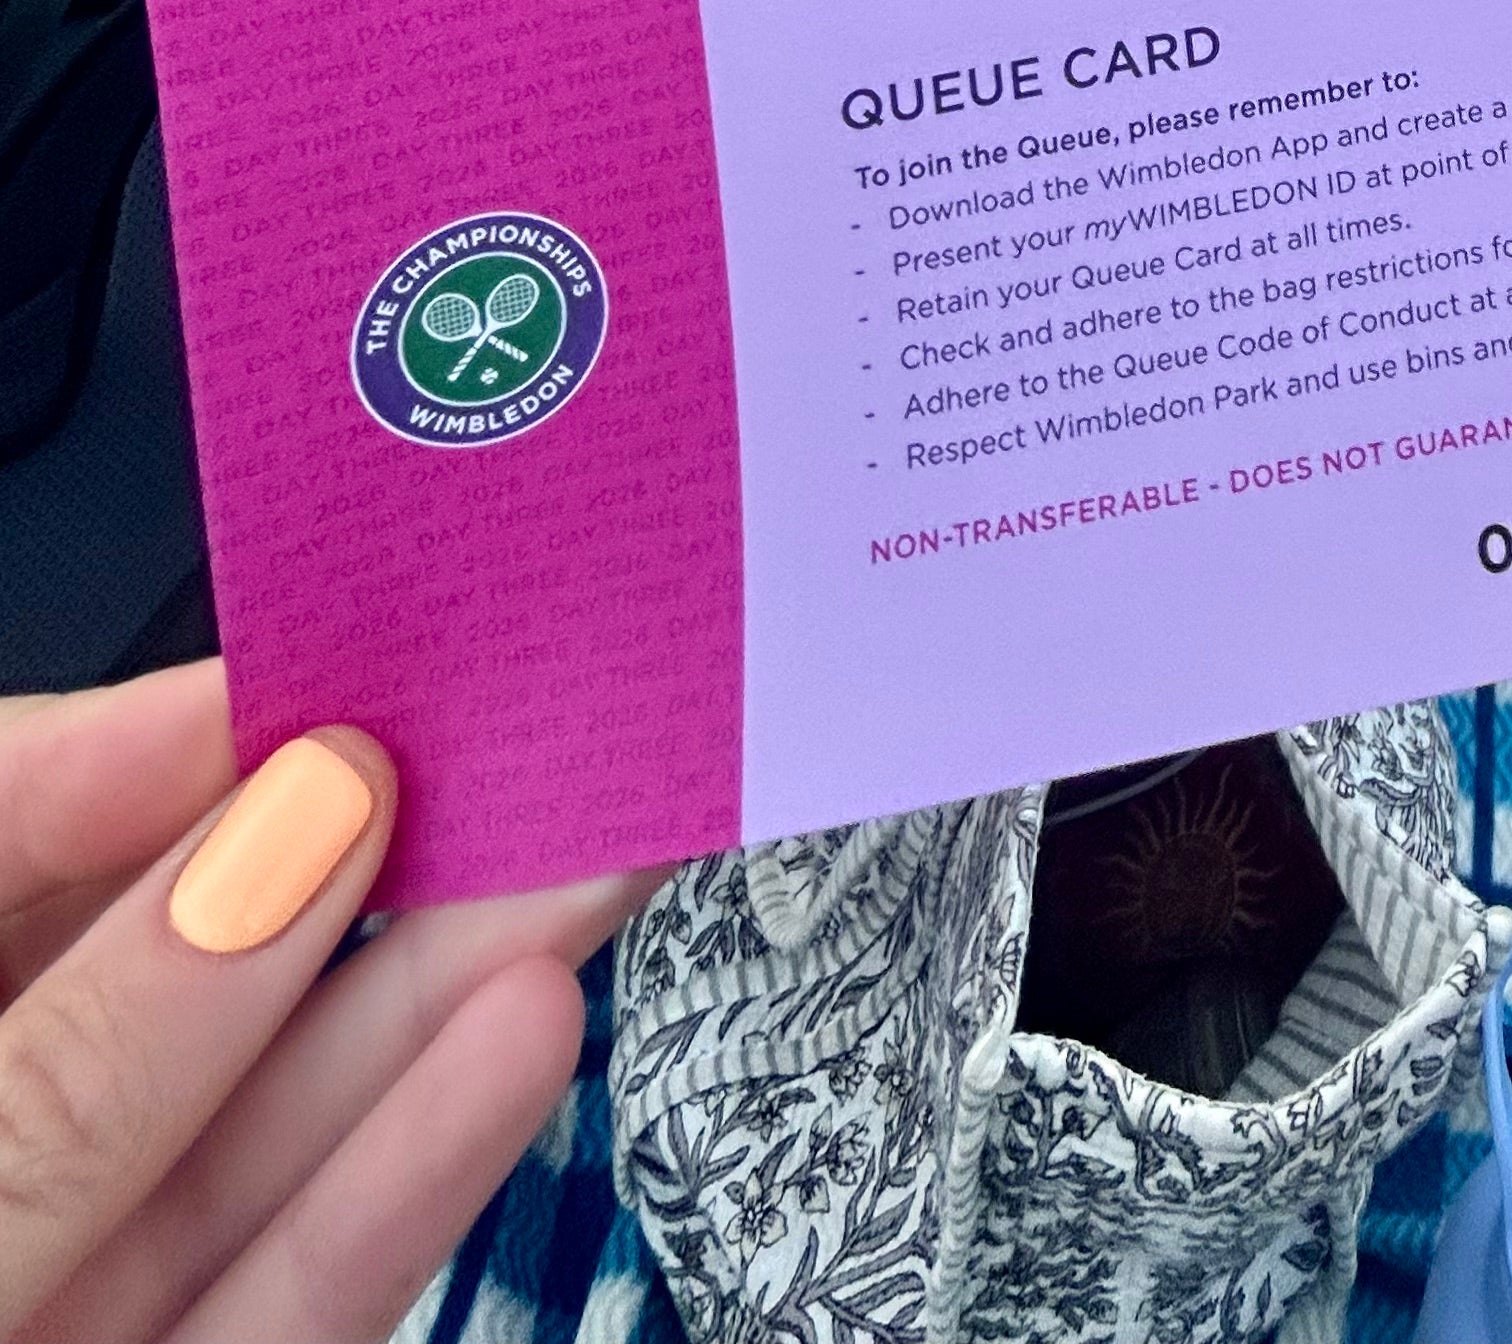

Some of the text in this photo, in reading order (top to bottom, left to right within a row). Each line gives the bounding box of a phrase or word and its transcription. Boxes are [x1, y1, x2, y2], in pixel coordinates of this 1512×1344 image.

[839, 25, 1221, 131] QUEUE CARD
[852, 68, 1421, 191] To join the Queue, please remember to:
[888, 179, 1036, 231] Download
[1041, 174, 1090, 203] the
[1096, 143, 1263, 191] Wimbledon
[1269, 131, 1330, 162] App
[1336, 113, 1390, 149] and
[1396, 102, 1484, 138] create
[1490, 99, 1509, 120] a
[892, 234, 1004, 277] Present
[1009, 224, 1076, 260] your
[1083, 175, 1319, 243] myWIMBLEDON
[1326, 169, 1357, 197] ID
[1364, 162, 1394, 190] at
[1400, 147, 1476, 189] point
[1480, 138, 1511, 168] of
[364, 223, 593, 355] THE CHAMPIONSHIPS
[896, 212, 1412, 325] Retain your Queue Card at all times.
[899, 330, 992, 371] Check
[998, 317, 1054, 353] and
[1061, 304, 1163, 341] adhere
[1168, 295, 1201, 321] to
[1207, 285, 1256, 314] the
[1261, 275, 1318, 305] bag
[1324, 244, 1485, 292] restrictions
[408, 364, 575, 434] WIMBLEDON
[903, 381, 1011, 421] Adhere
[1017, 373, 1050, 399] to
[1056, 362, 1105, 391] the
[1112, 344, 1209, 380] Queue
[1216, 324, 1295, 361] Code
[1300, 314, 1331, 346] of
[1338, 292, 1463, 338] Conduct
[1469, 285, 1499, 315] at
[906, 423, 1028, 471] Respect
[1033, 394, 1207, 445] Wimbledon
[1213, 375, 1279, 411] Park
[1285, 361, 1340, 398] and
[1347, 358, 1398, 386] use
[1404, 344, 1467, 375] bins
[870, 477, 1200, 565] NON-TRANSFERABLE
[1228, 455, 1314, 495] DOES
[1321, 440, 1385, 476] NOT
